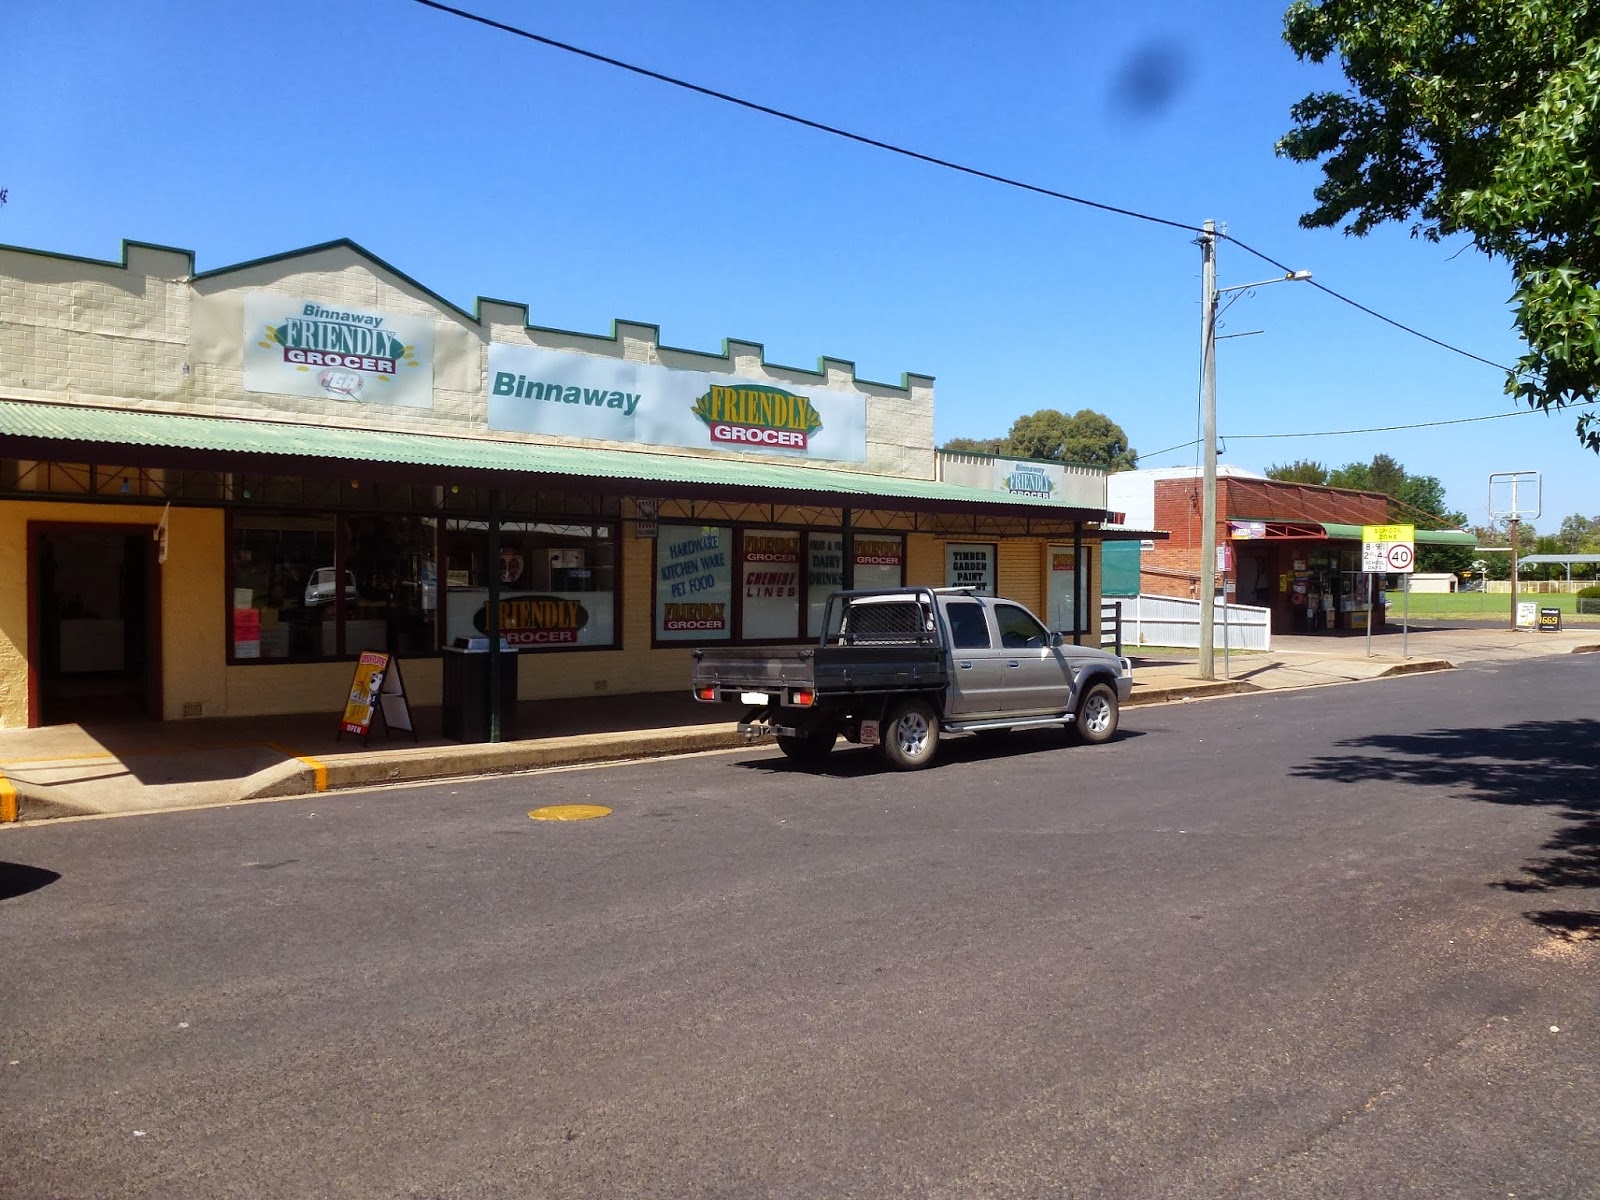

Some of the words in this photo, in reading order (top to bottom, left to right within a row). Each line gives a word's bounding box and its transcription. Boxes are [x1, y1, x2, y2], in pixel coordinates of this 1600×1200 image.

[303, 304, 383, 328] Binnaway
[286, 317, 396, 359] FRIENDLY
[287, 350, 393, 373] GROCER
[492, 371, 641, 416] Binnaway
[709, 384, 811, 430] FRIENDLY
[714, 425, 804, 446] GROCER
[1015, 463, 1045, 475] Binnaway
[1010, 472, 1050, 492] FRIENDLY
[669, 535, 719, 559] HARDWARE
[746, 553, 796, 562] GROCER
[812, 555, 841, 569] DAIRY
[856, 556, 899, 564] GROCER
[953, 551, 987, 561] TIMBER
[1391, 551, 1409, 562] 40
[661, 560, 699, 581] KITCHEN
[700, 552, 726, 571] WARE
[953, 562, 987, 571] GARDEN
[745, 571, 797, 586] CHEMIST
[957, 572, 984, 581] PAINT
[671, 581, 687, 598] PET
[688, 574, 715, 594] FOOD
[746, 586, 796, 598] LINES
[667, 620, 722, 629] GROCER
[500, 630, 573, 643] ROCER
[346, 723, 362, 734] OPEN
